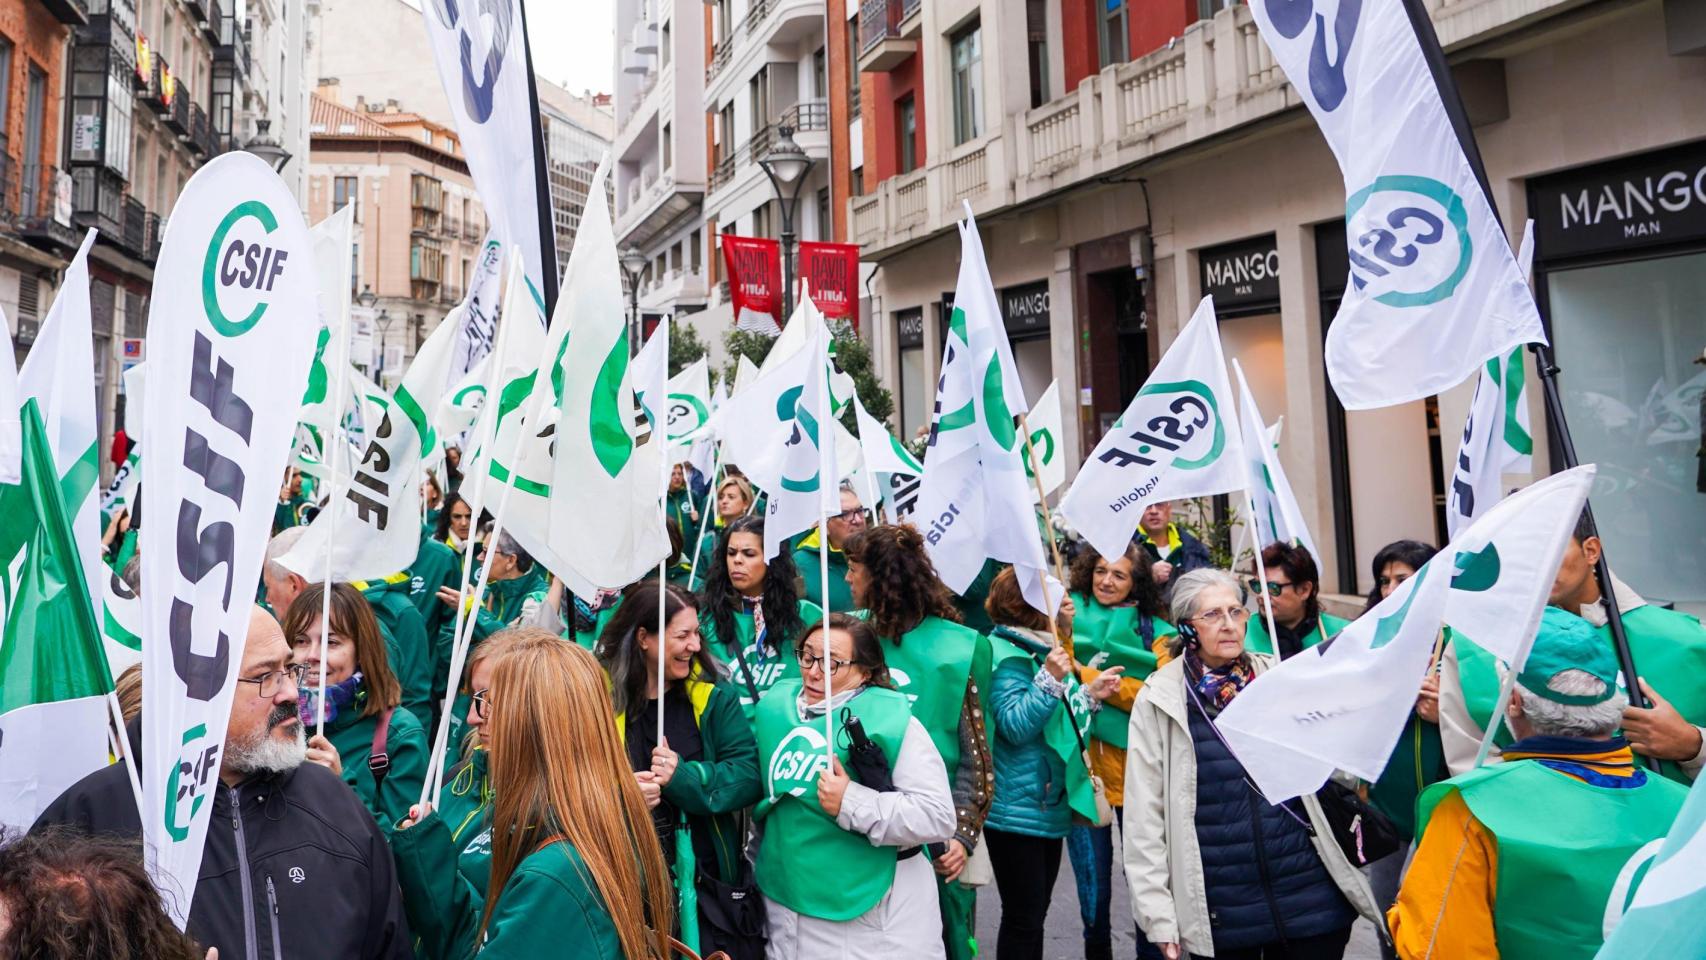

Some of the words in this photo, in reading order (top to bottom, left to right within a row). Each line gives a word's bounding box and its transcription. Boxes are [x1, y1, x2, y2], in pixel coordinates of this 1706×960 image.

[1624, 221, 1660, 238] MAN
[220, 239, 288, 291] CSIF
[733, 249, 769, 273] DAVID
[811, 255, 847, 279] DAVID
[1206, 249, 1280, 287] MANGO
[1234, 285, 1252, 296] MAN
[900, 316, 923, 335] MANG
[169, 329, 254, 702] CSIF
[735, 663, 786, 686] CSIF
[774, 750, 828, 782] CSIF
